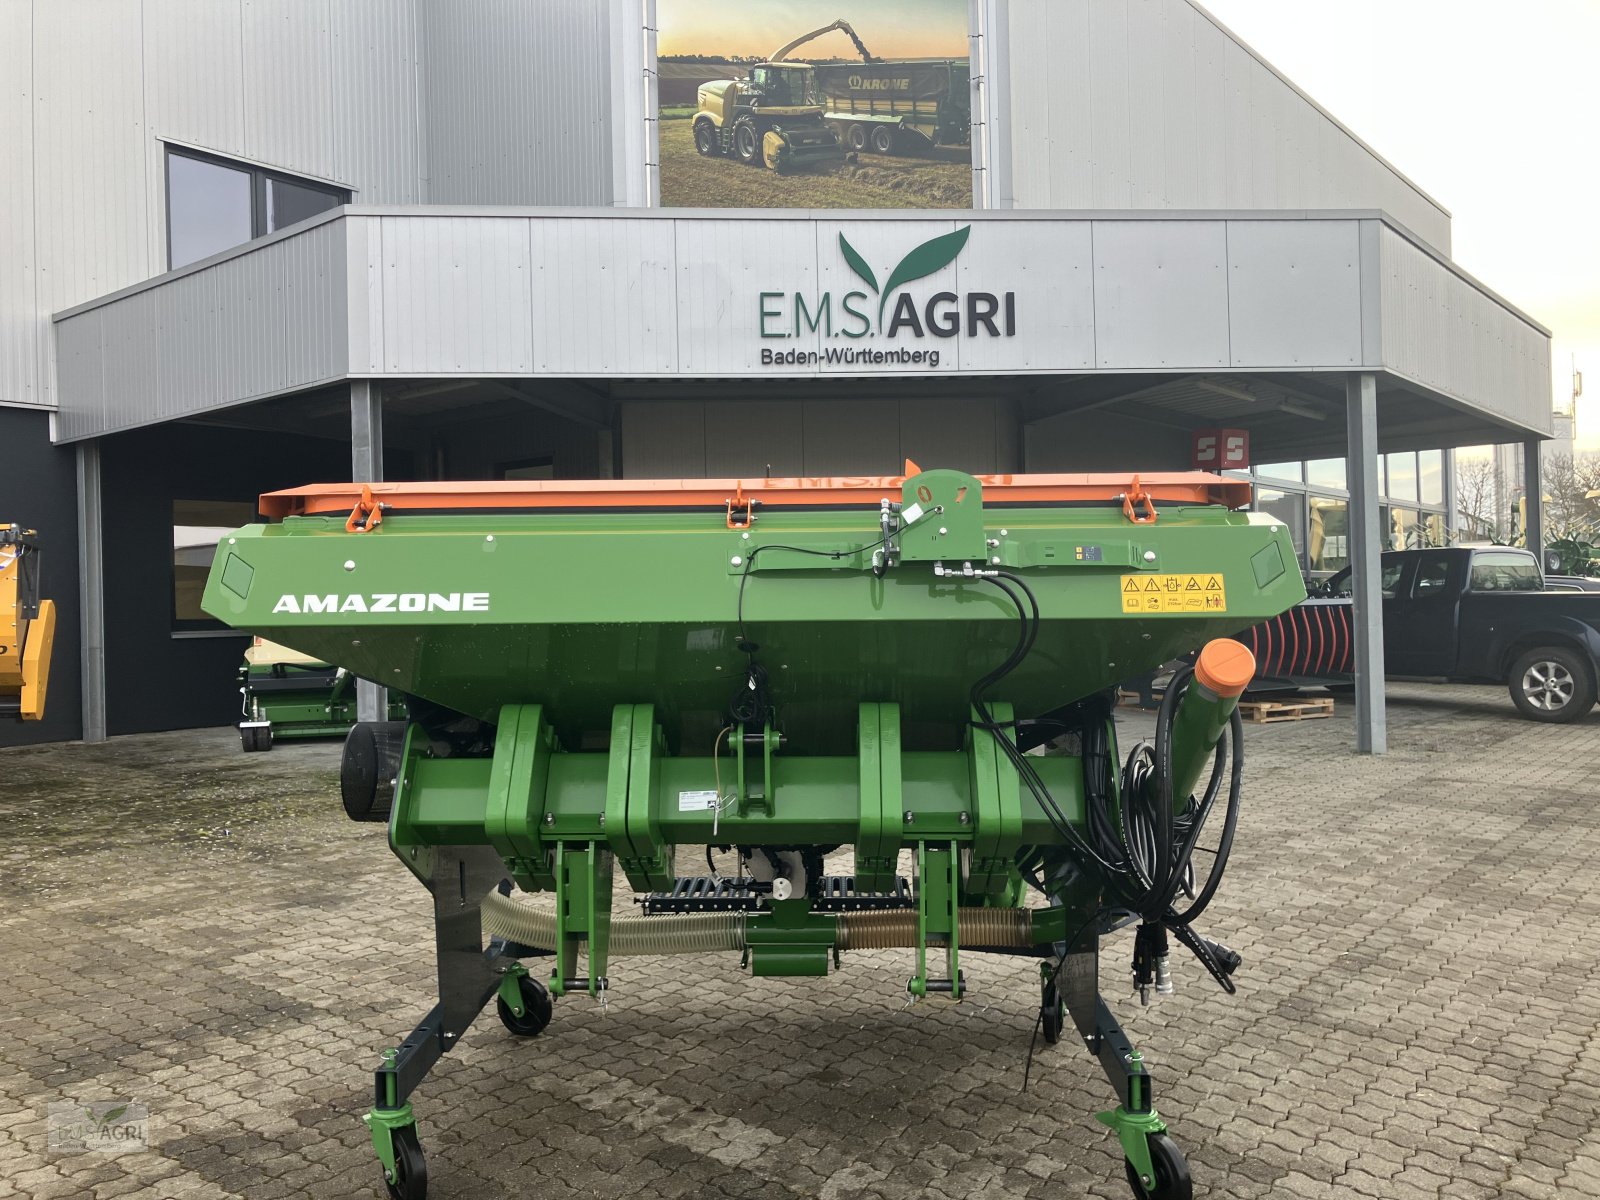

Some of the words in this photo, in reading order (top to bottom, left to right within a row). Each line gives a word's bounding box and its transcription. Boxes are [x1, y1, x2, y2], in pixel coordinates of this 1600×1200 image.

[862, 79, 909, 89] KRONE
[887, 291, 1015, 338] AGRI
[761, 347, 939, 367] Baden-Württemberg
[272, 592, 489, 614] AMAZONE
